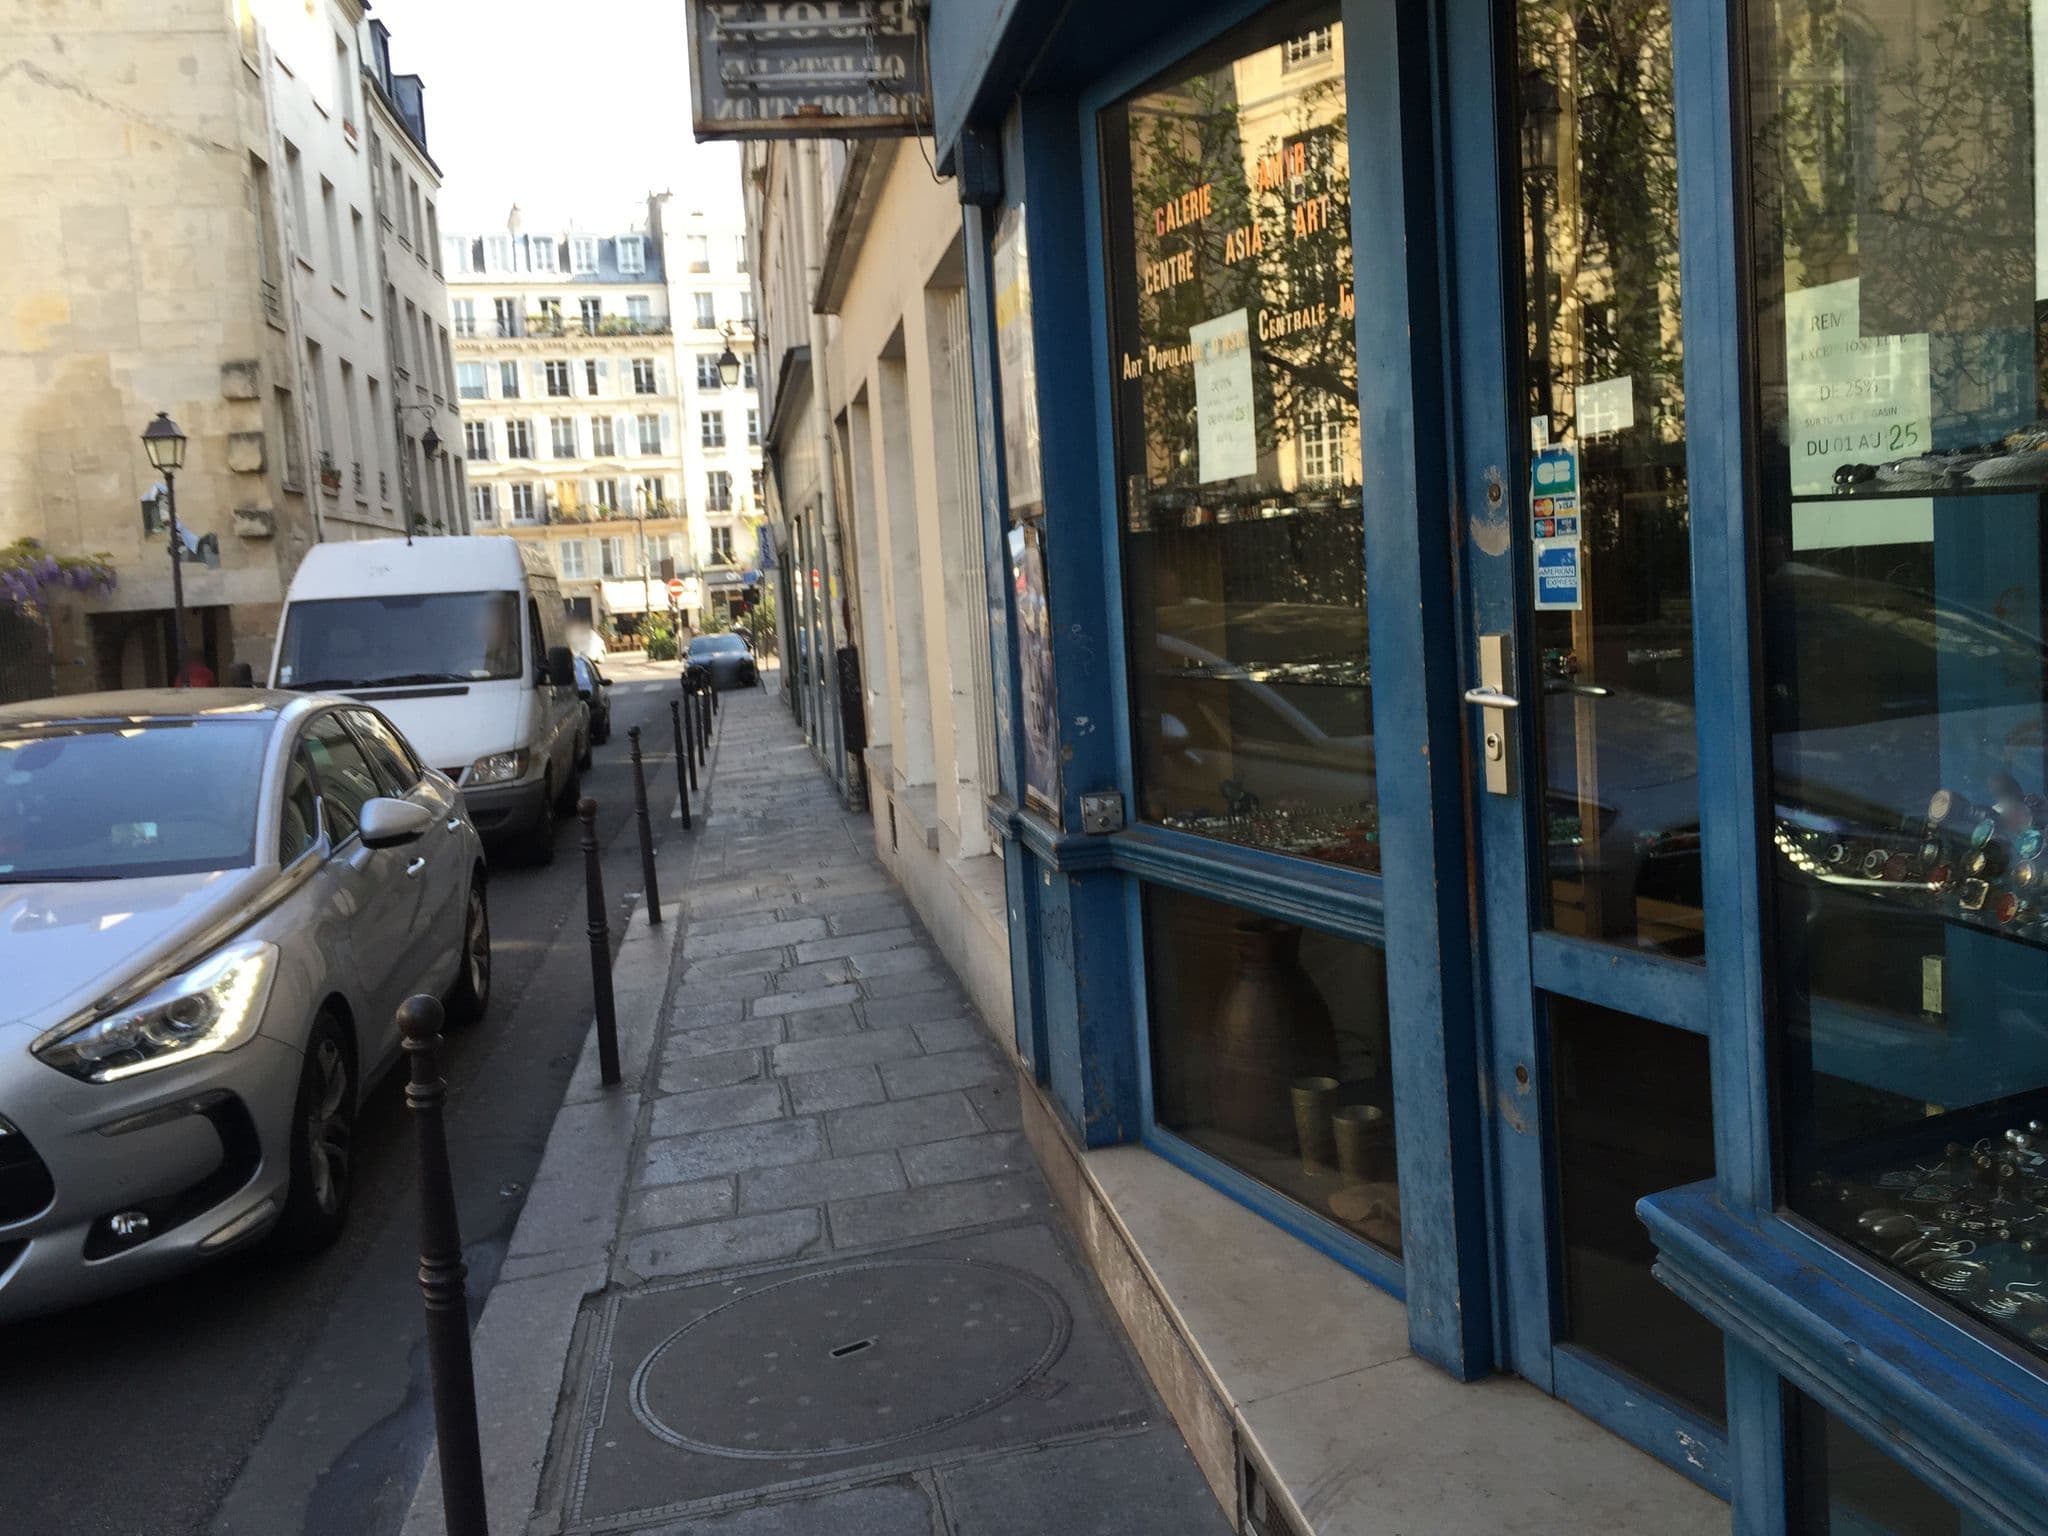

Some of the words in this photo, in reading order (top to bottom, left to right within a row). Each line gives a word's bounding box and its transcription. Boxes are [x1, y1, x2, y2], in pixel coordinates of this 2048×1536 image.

[1155, 183, 1213, 237] GALERIE
[1144, 250, 1194, 295] CENTRE
[1225, 224, 1263, 265] ASIA
[1294, 194, 1329, 240] ART
[1807, 438, 1829, 457] DU
[1889, 421, 1919, 451] 25
